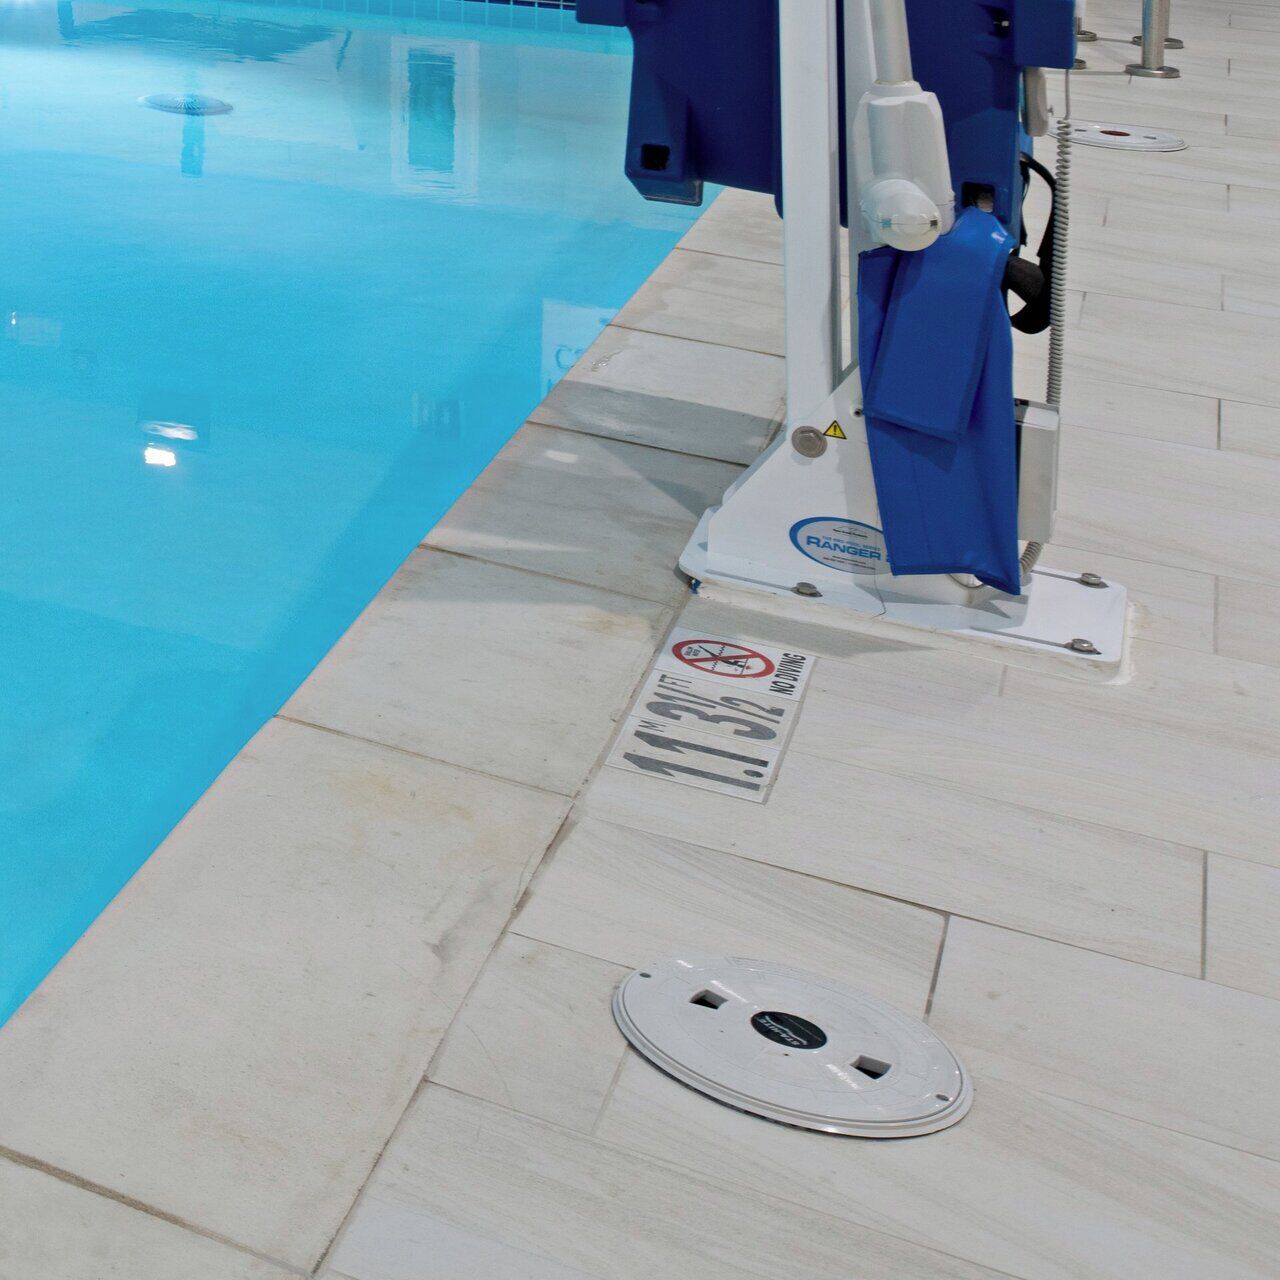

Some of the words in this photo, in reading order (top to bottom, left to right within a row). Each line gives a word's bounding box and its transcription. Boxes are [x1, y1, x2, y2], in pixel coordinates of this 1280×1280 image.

[806, 535, 882, 561] RANGER
[774, 652, 807, 683] DIVING
[769, 680, 794, 696] NO
